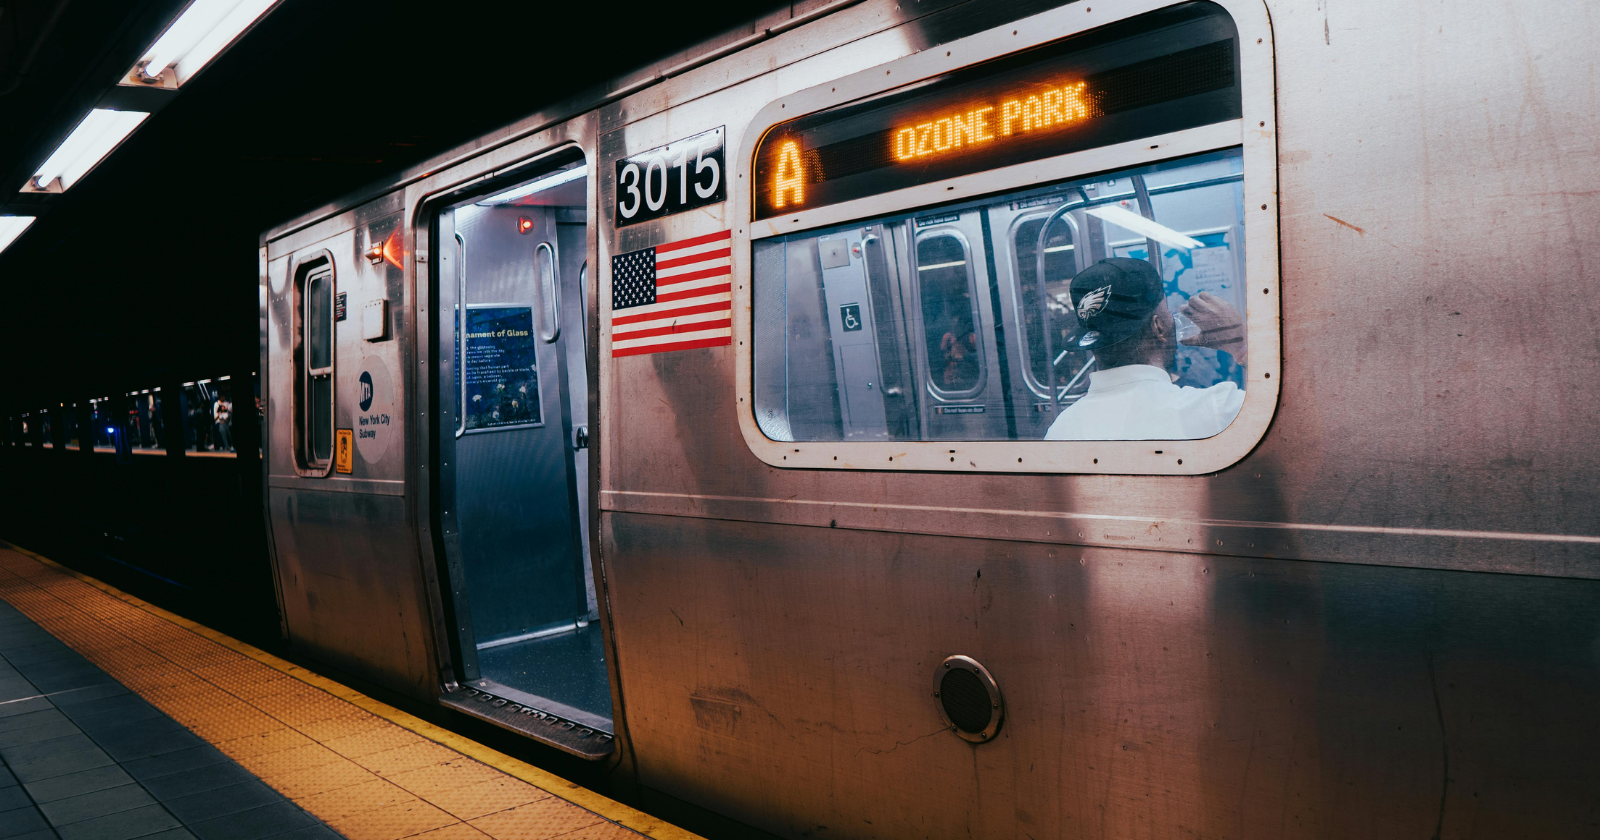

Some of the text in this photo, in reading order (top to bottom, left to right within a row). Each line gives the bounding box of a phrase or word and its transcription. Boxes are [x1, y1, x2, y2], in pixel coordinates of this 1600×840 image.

[896, 82, 1085, 161] OZONE PARK
[620, 141, 720, 218] 3015
[775, 140, 804, 207] A
[360, 381, 371, 403] MTA
[359, 413, 390, 426] New York City
[359, 429, 376, 439] Subway
